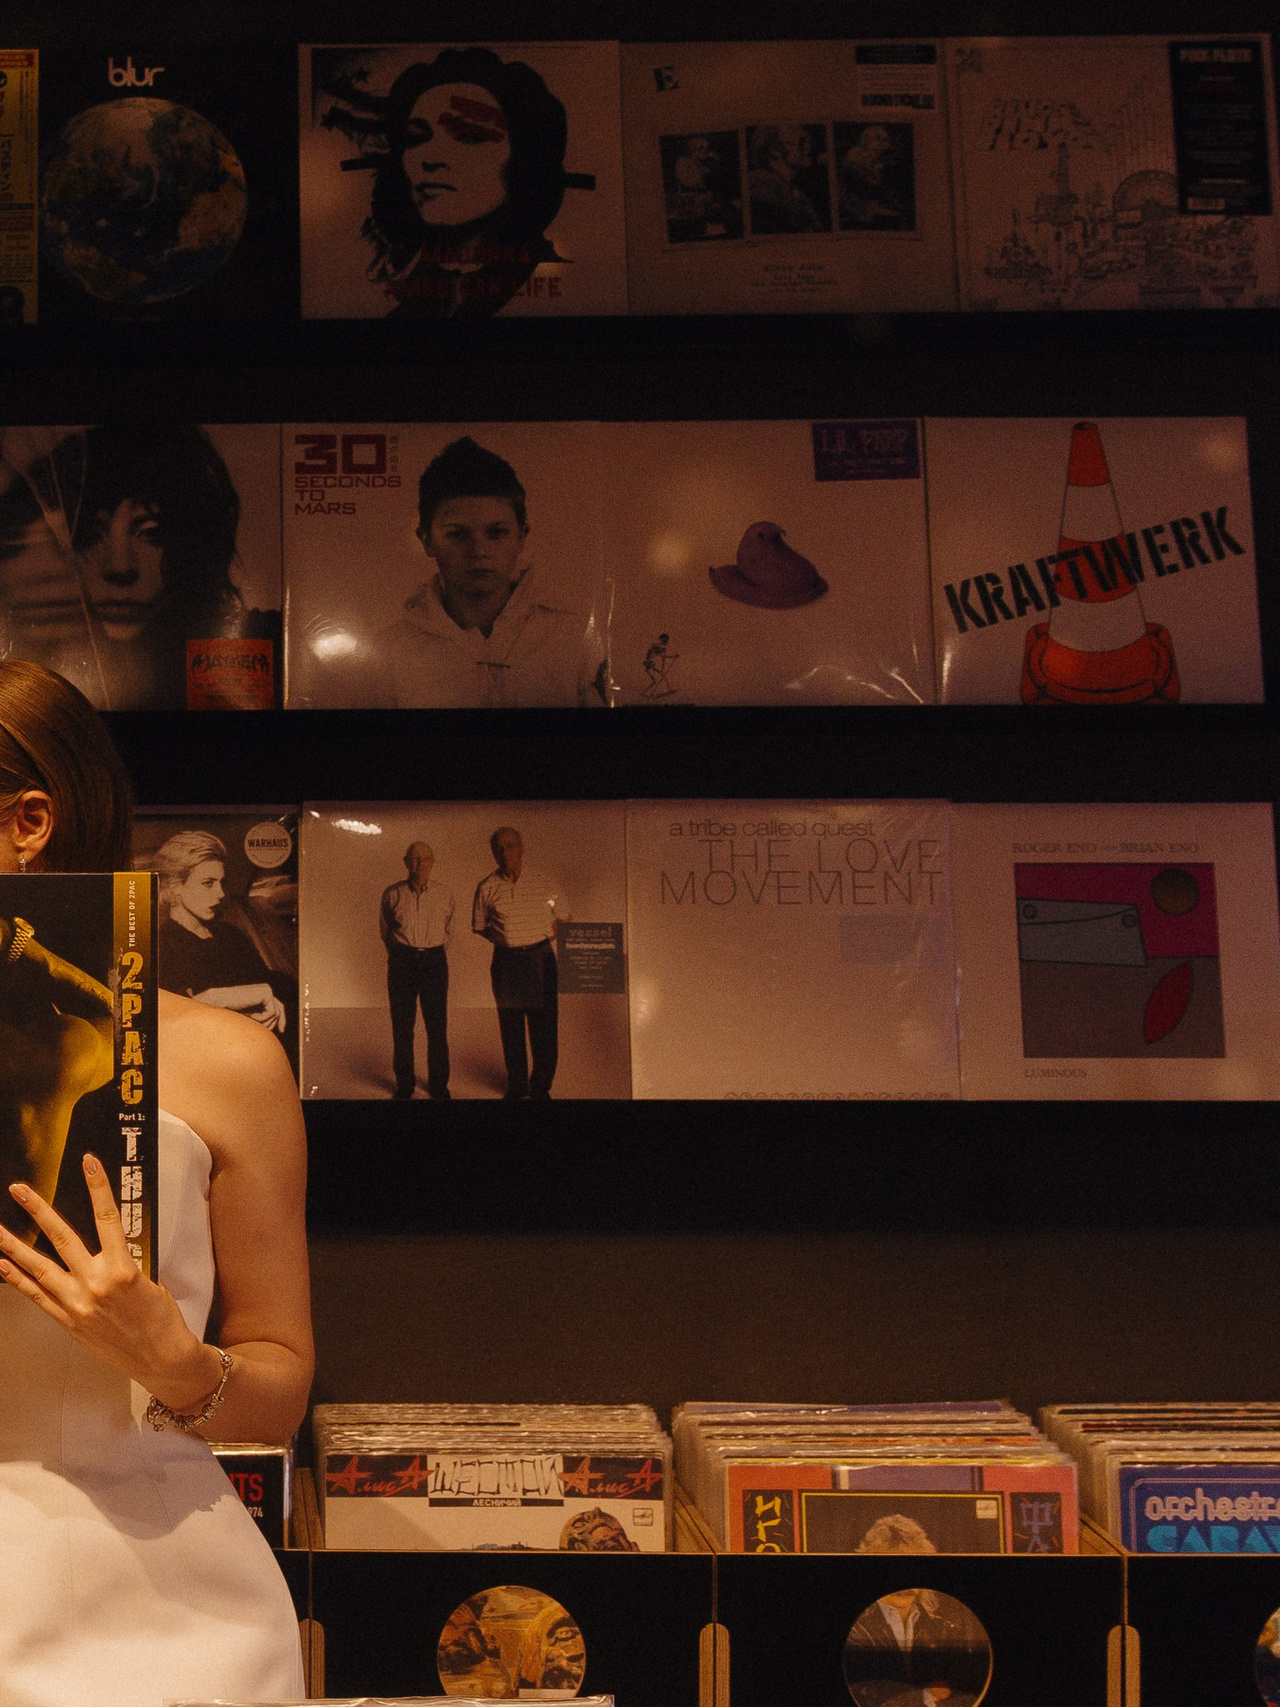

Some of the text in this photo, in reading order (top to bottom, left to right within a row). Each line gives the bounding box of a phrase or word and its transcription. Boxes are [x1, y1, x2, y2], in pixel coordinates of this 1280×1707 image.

[107, 55, 166, 87] blur
[652, 65, 679, 92] E
[512, 276, 562, 299] LIFE
[295, 434, 387, 475] 30
[294, 475, 402, 488] SECONDS
[295, 489, 325, 502] TO
[294, 502, 357, 515] MARS
[943, 505, 1247, 634] KRAFTWERK
[668, 820, 877, 840] a tribe called quest
[248, 838, 288, 848] WARHAUS
[1012, 843, 1061, 854] ROGER
[697, 837, 944, 875] THE LOVE
[661, 870, 944, 905] MOVEMENT
[128, 880, 136, 948] THE BEST OF 2PAC
[569, 926, 612, 938] vessel
[120, 951, 144, 1105] 2PAC
[118, 1112, 146, 1121] Part 1:
[472, 1498, 522, 1507] ЛЕСНИЧИЙ
[1145, 1487, 1280, 1521] orchestr
